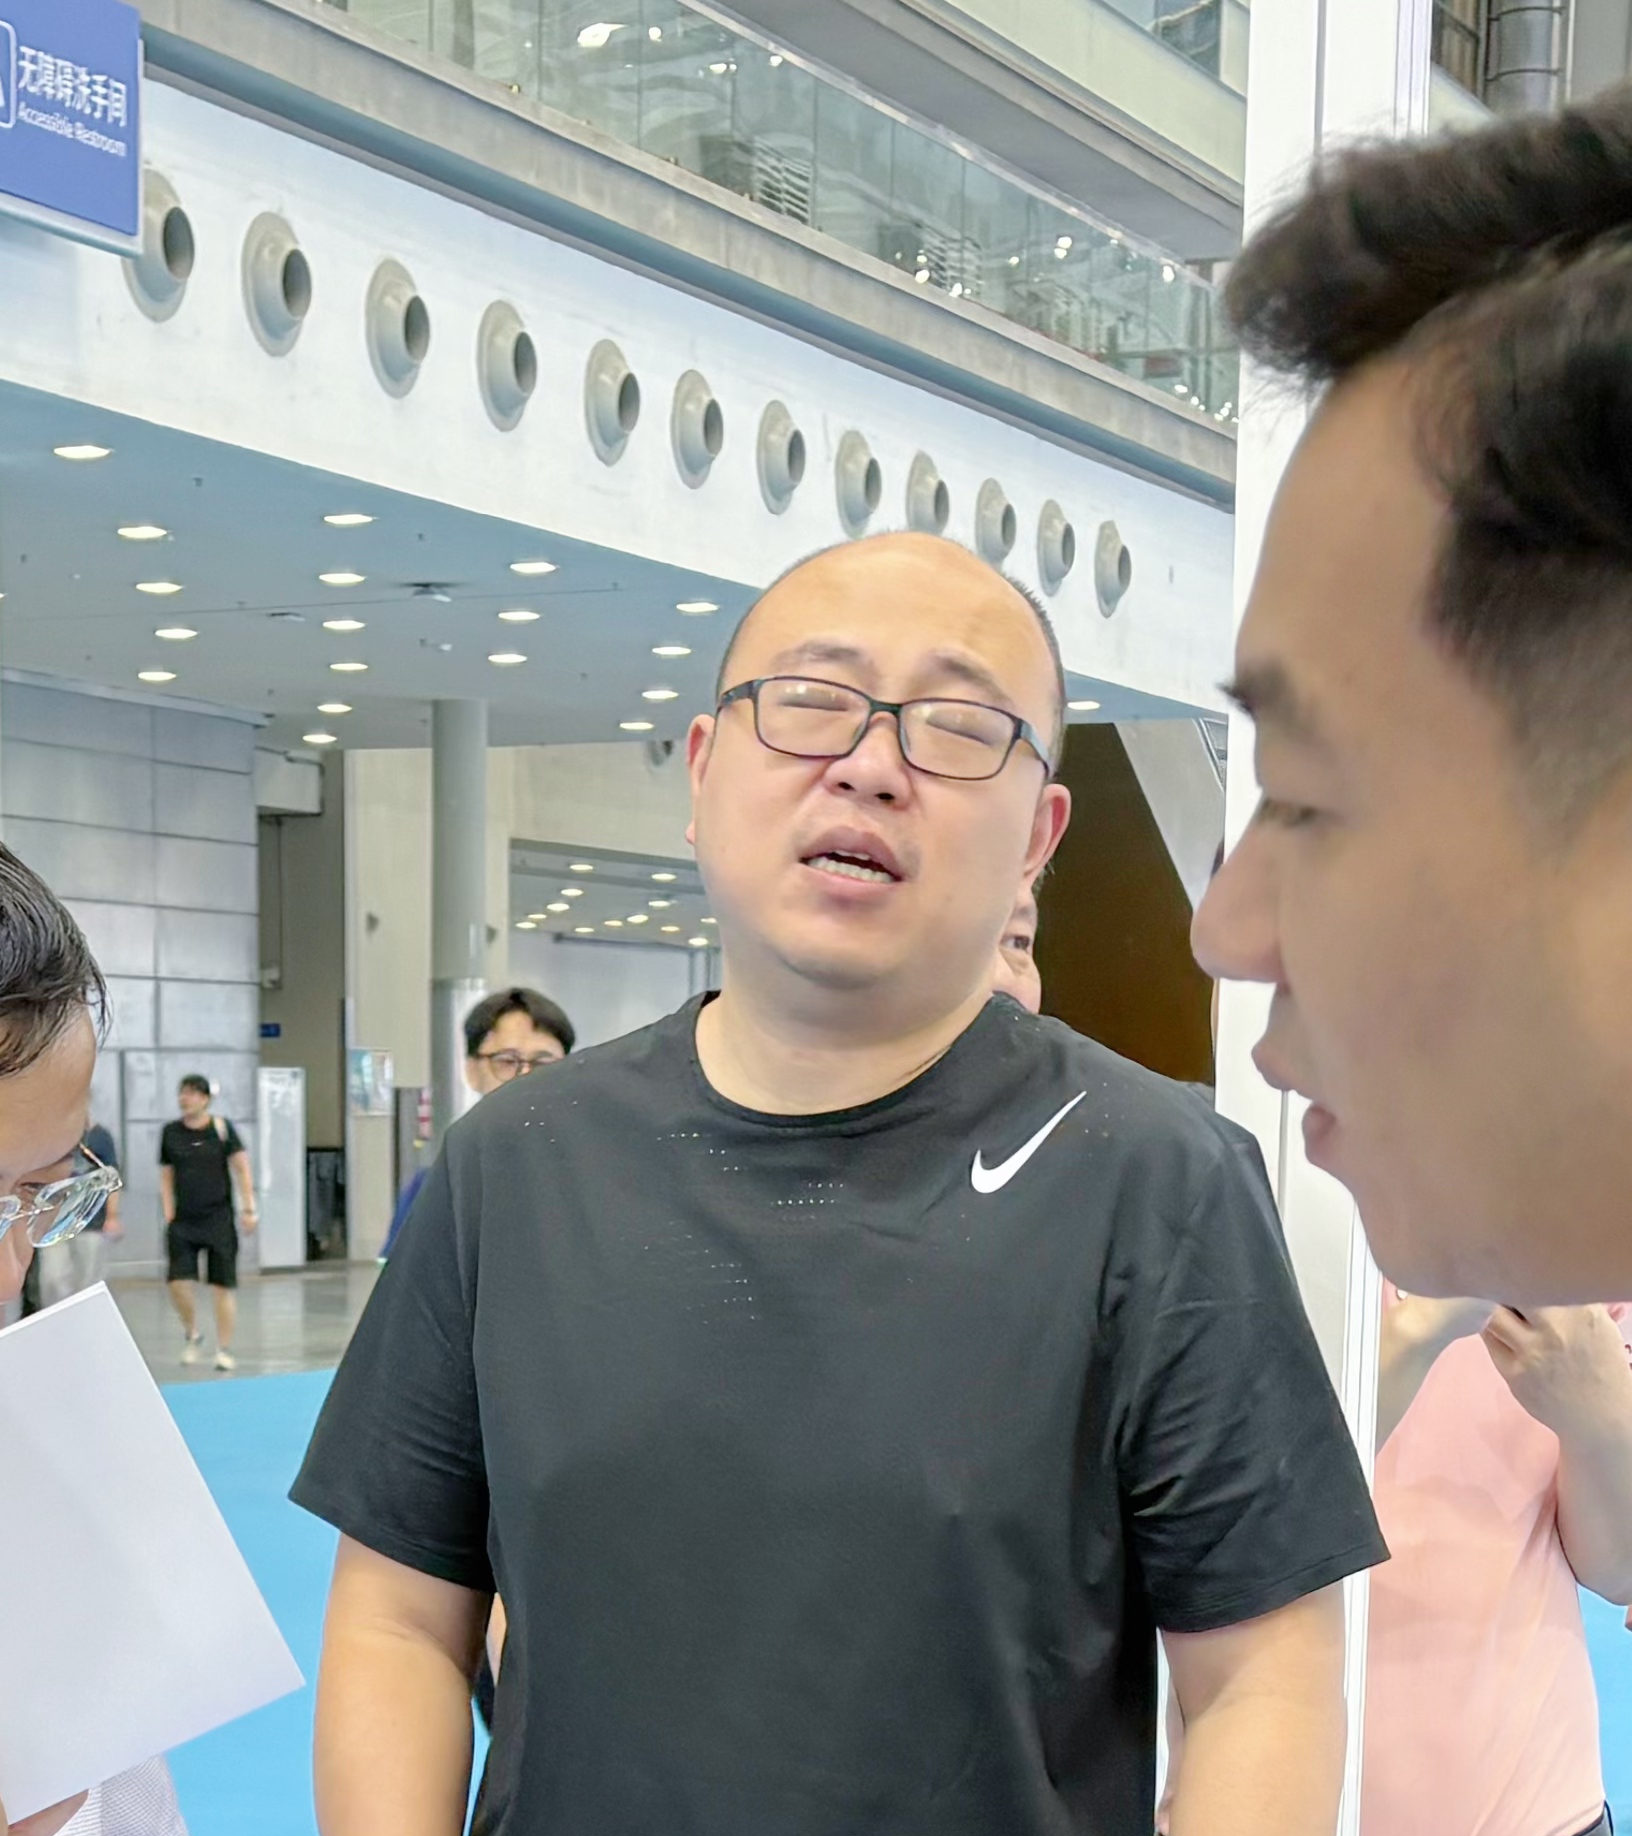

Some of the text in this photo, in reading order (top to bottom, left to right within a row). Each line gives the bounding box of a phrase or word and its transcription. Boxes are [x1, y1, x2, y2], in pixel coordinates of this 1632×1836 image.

[18, 45, 127, 127] 无障碍洗手间
